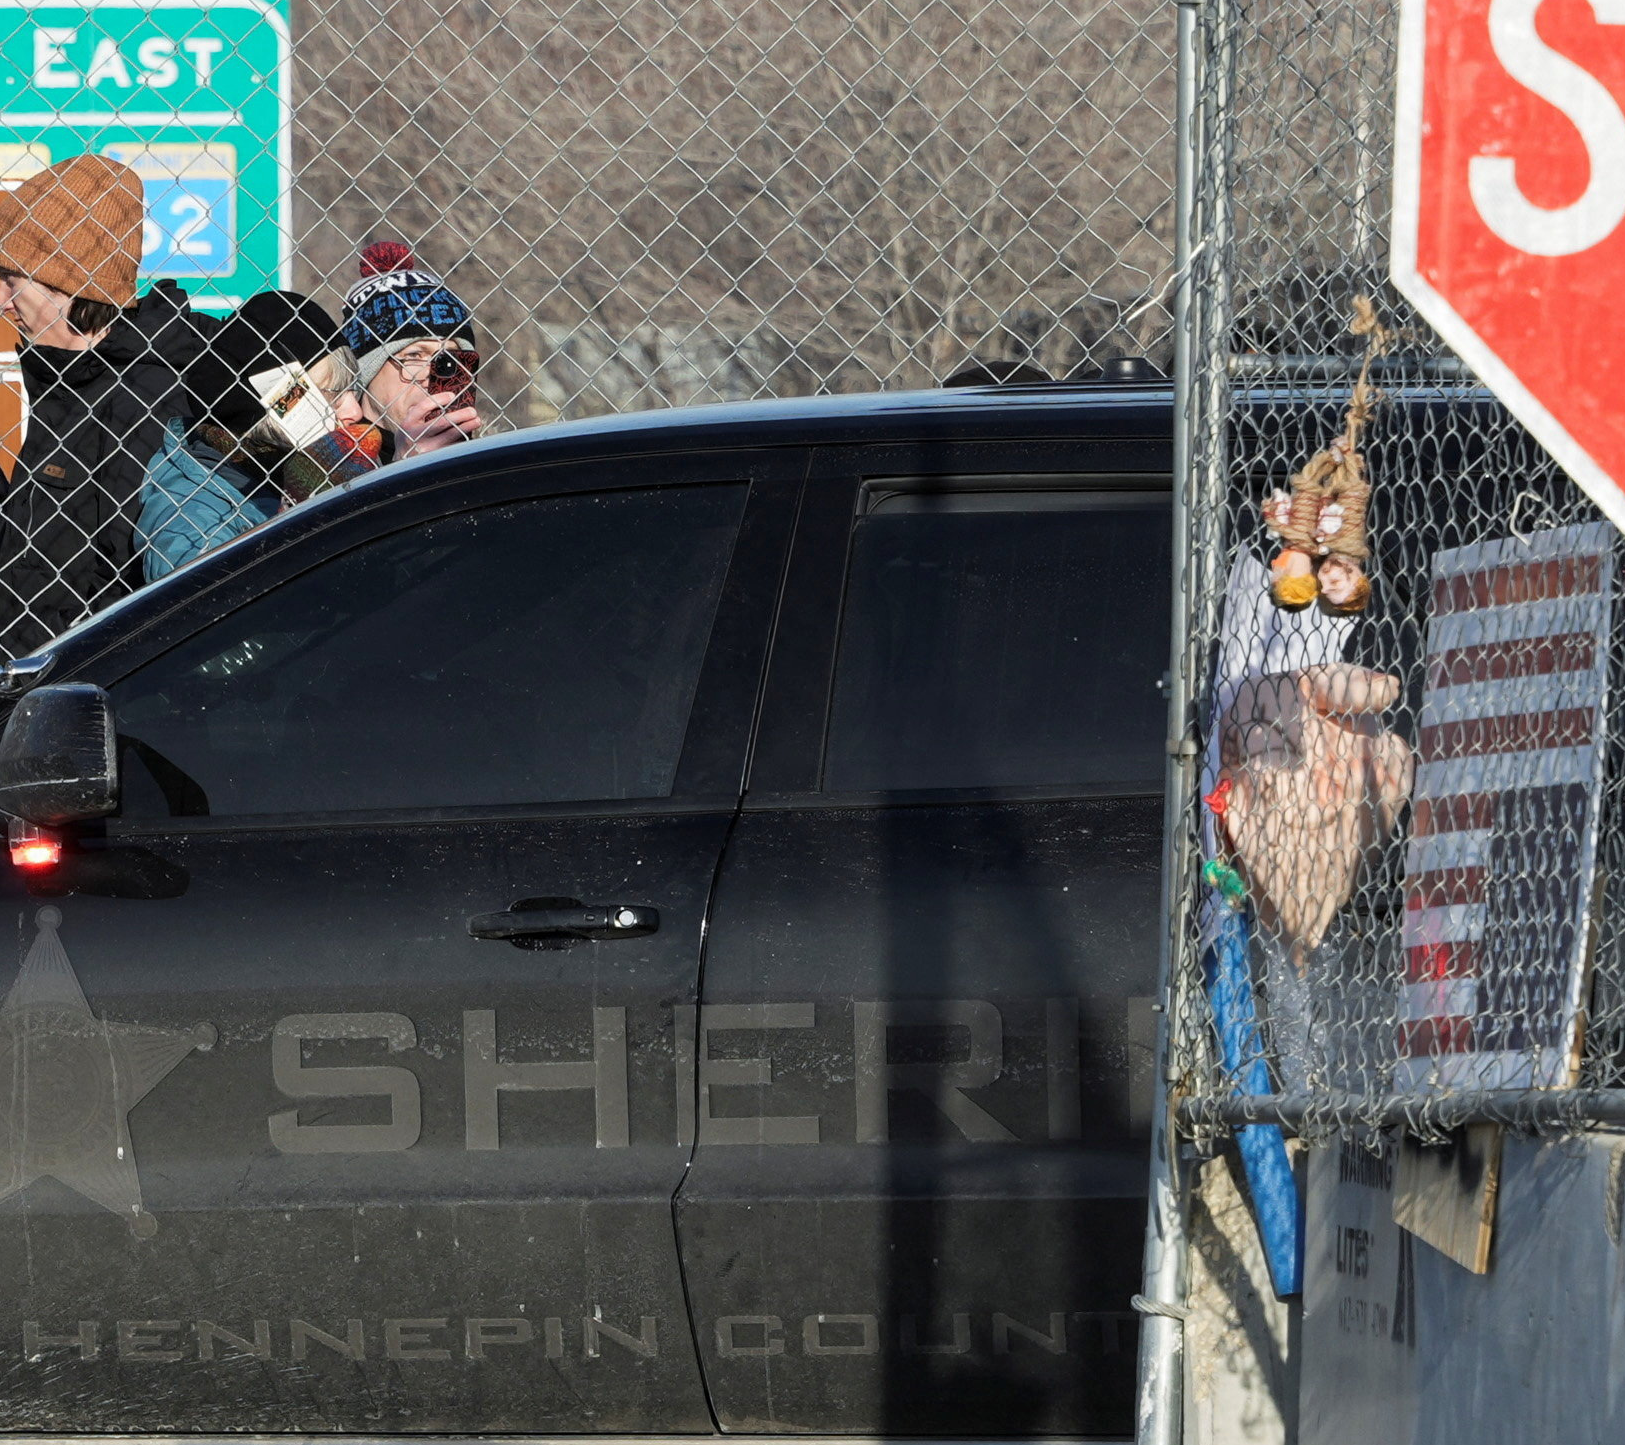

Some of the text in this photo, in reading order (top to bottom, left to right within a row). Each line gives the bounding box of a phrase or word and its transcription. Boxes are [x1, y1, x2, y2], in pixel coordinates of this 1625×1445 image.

[32, 26, 224, 89] EAST
[372, 288, 456, 317] FUCK
[267, 996, 1155, 1152] SHERI
[1339, 1136, 1393, 1192] WARNING
[1335, 1223, 1369, 1279] LITES
[22, 1311, 1140, 1363] HENNEPIN COUNT
